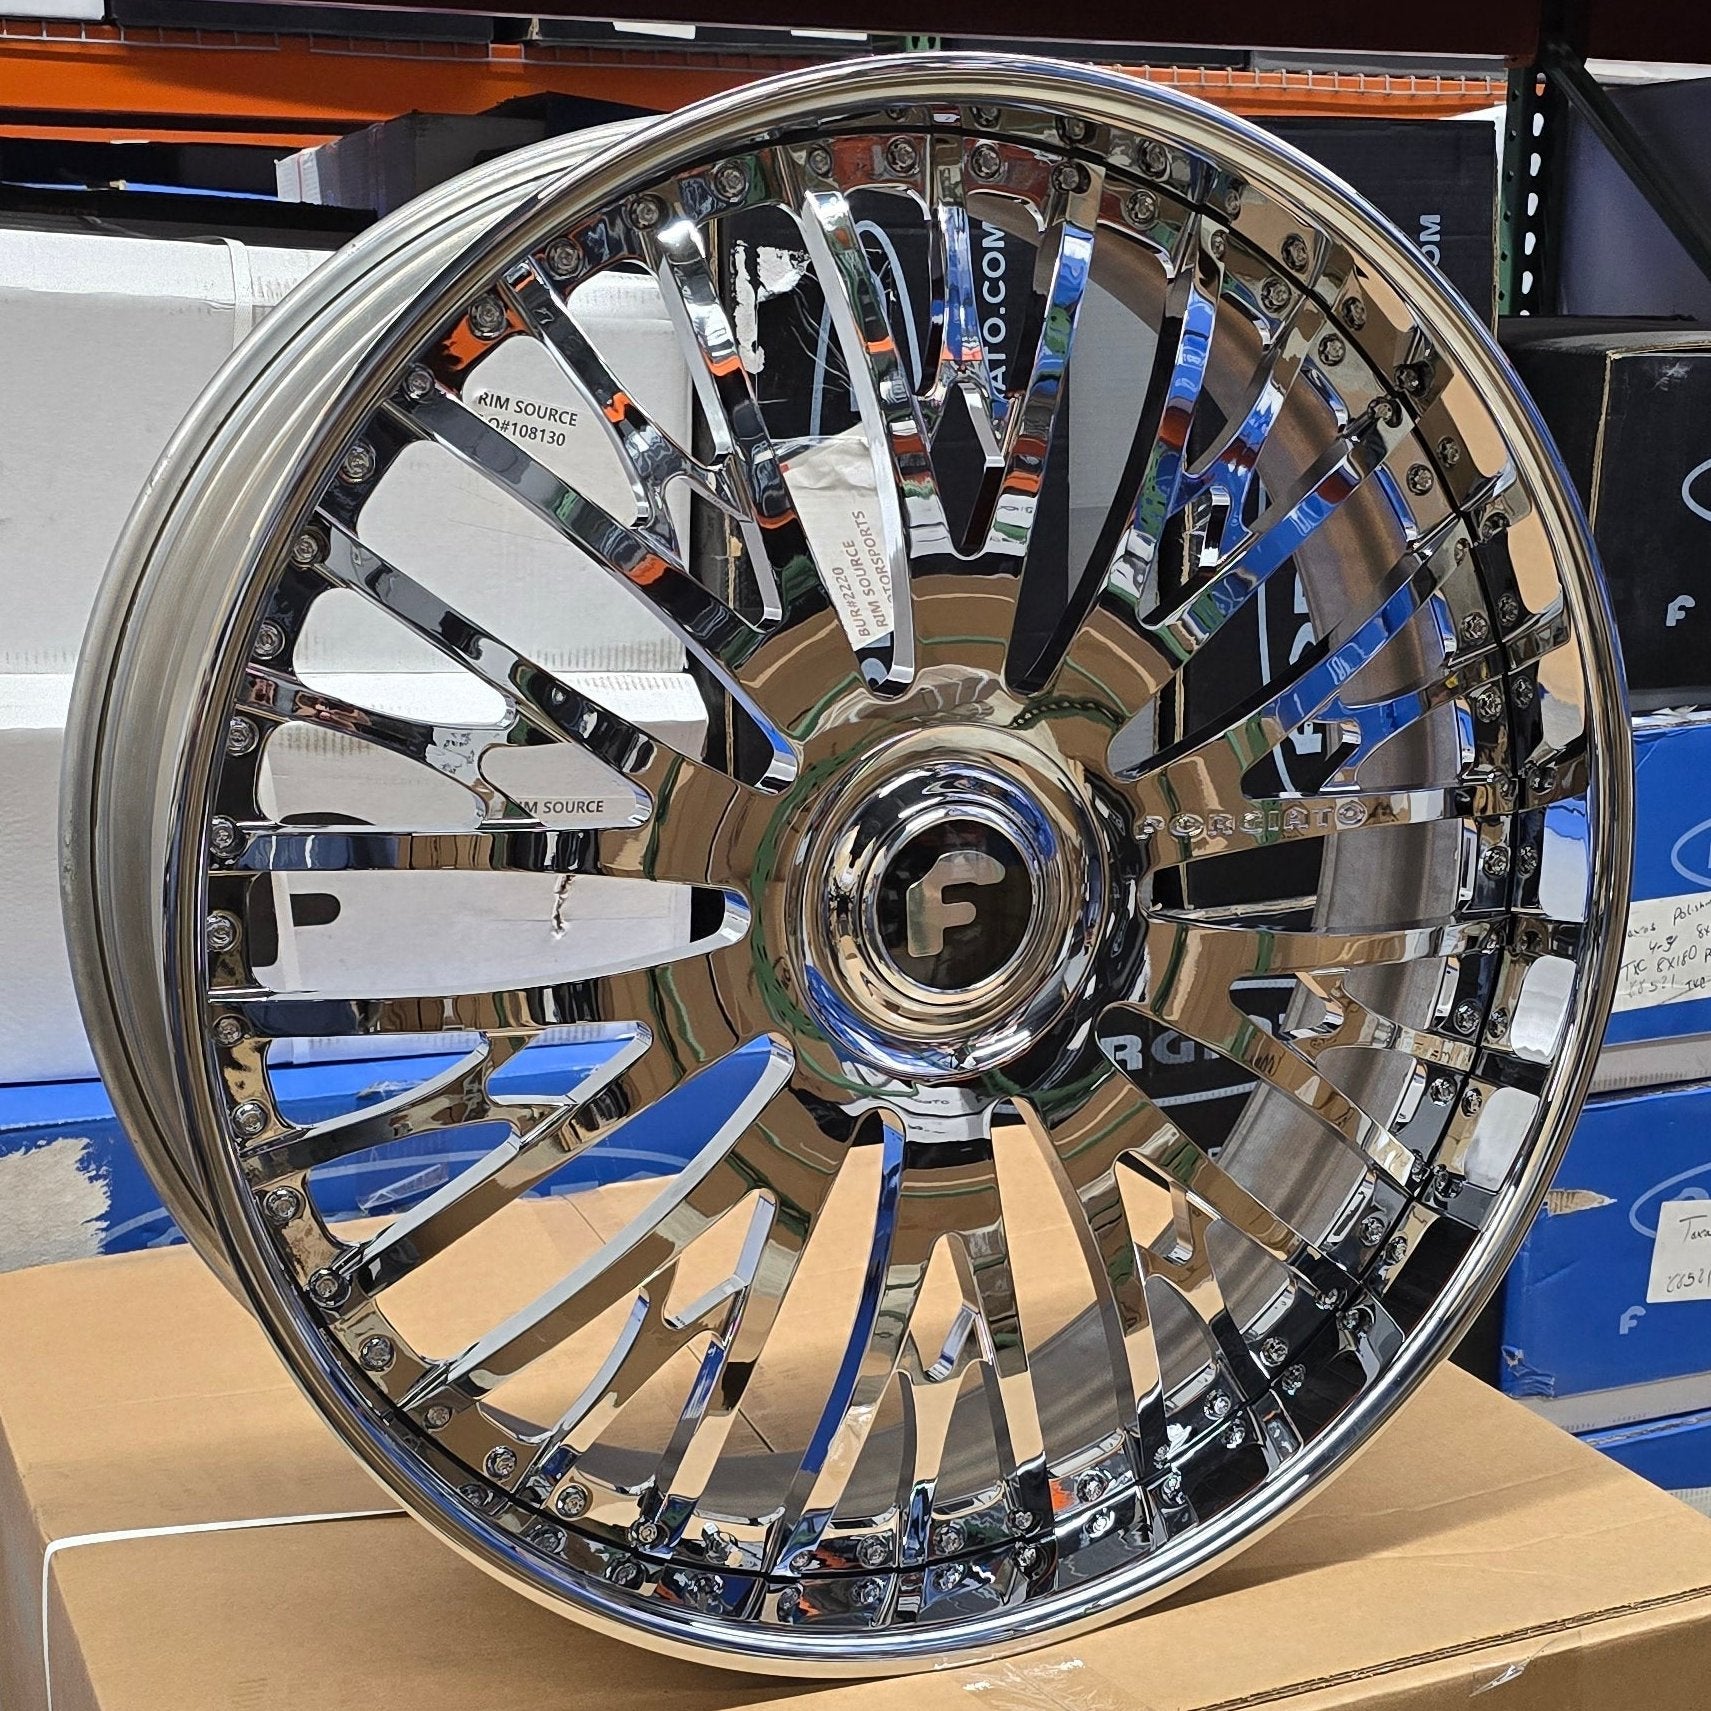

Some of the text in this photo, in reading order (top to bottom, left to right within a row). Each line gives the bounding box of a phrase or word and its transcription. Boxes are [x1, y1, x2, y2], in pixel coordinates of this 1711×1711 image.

[477, 391, 578, 427] RIM SOURCE
[842, 539, 876, 597] SOURCE
[831, 566, 871, 637] BUR#2220
[868, 600, 889, 628] RIM
[542, 800, 605, 814] SOURCE
[905, 849, 1006, 958] F
